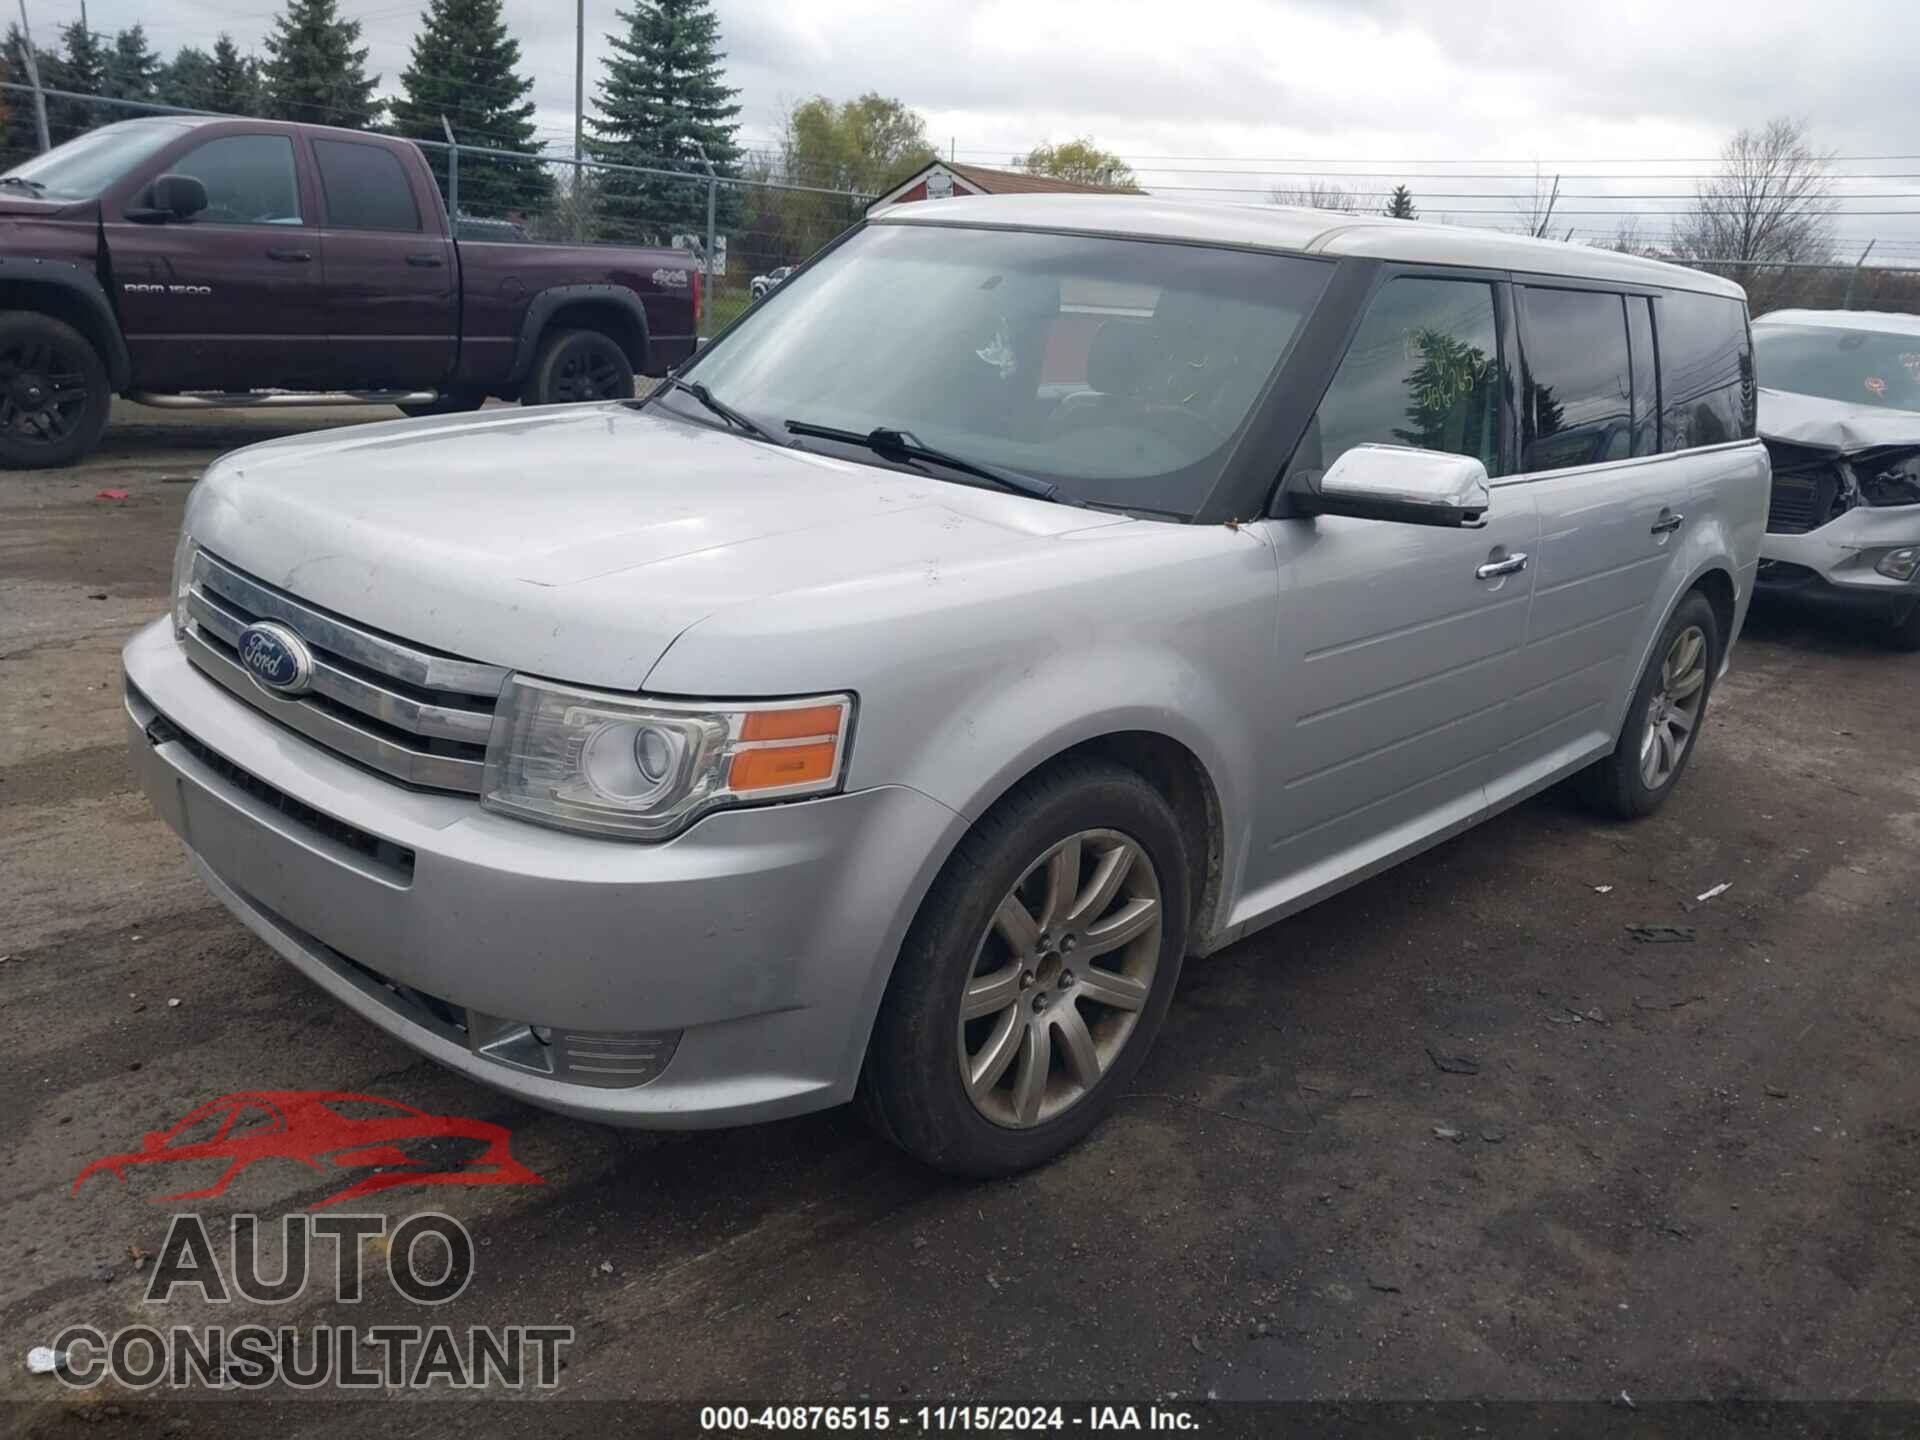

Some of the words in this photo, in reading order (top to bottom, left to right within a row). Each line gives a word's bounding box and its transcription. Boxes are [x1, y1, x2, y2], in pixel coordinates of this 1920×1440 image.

[123, 283, 164, 294] RAM
[169, 284, 212, 295] 1500
[244, 632, 284, 676] Ford
